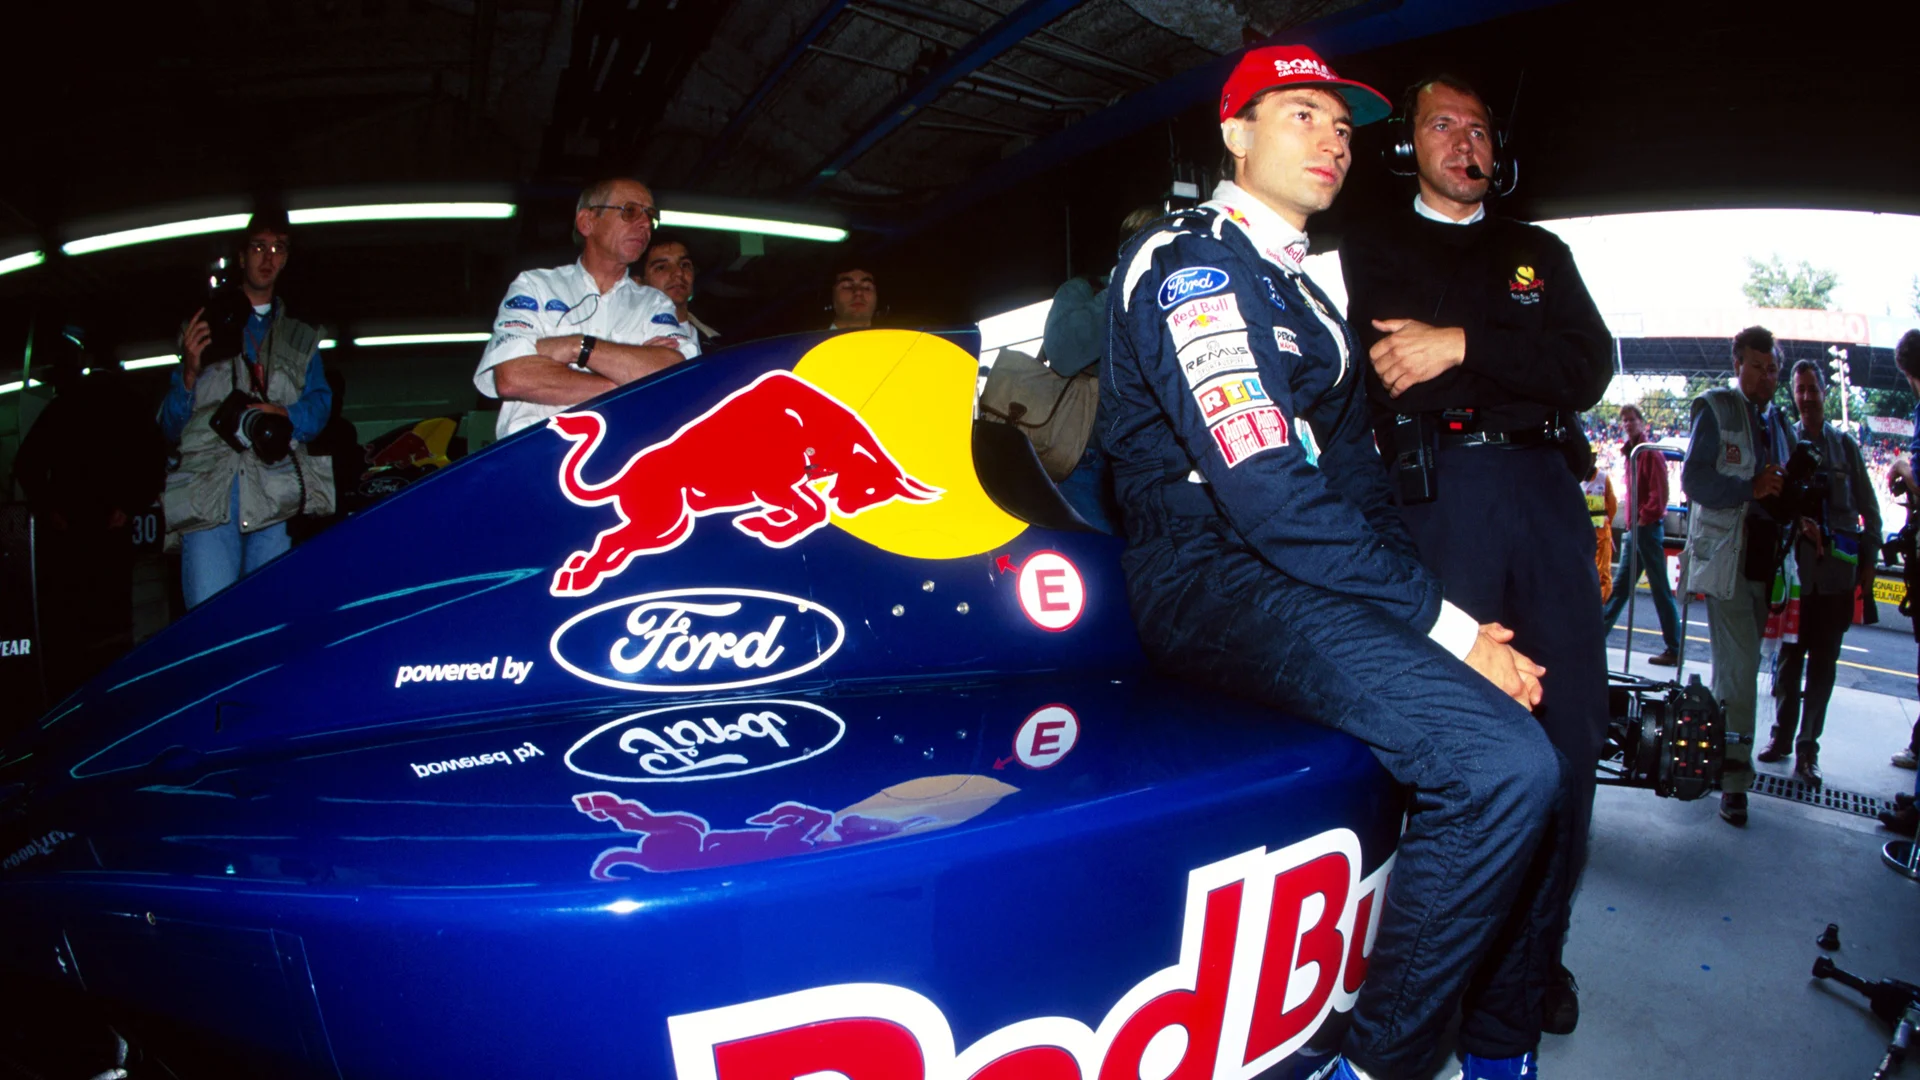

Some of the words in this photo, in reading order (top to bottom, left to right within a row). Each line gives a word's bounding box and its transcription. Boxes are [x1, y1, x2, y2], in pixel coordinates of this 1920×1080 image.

[1168, 270, 1214, 302] Ford
[1173, 303, 1198, 327] Red
[1200, 298, 1228, 313] Bull
[1185, 346, 1249, 374] REMUS
[1200, 380, 1264, 415] RTL
[132, 513, 157, 544] 30
[1035, 569, 1070, 611] E
[0, 638, 31, 657] EAR
[610, 601, 787, 674] Ford
[395, 657, 498, 687] powered
[502, 656, 533, 684] by
